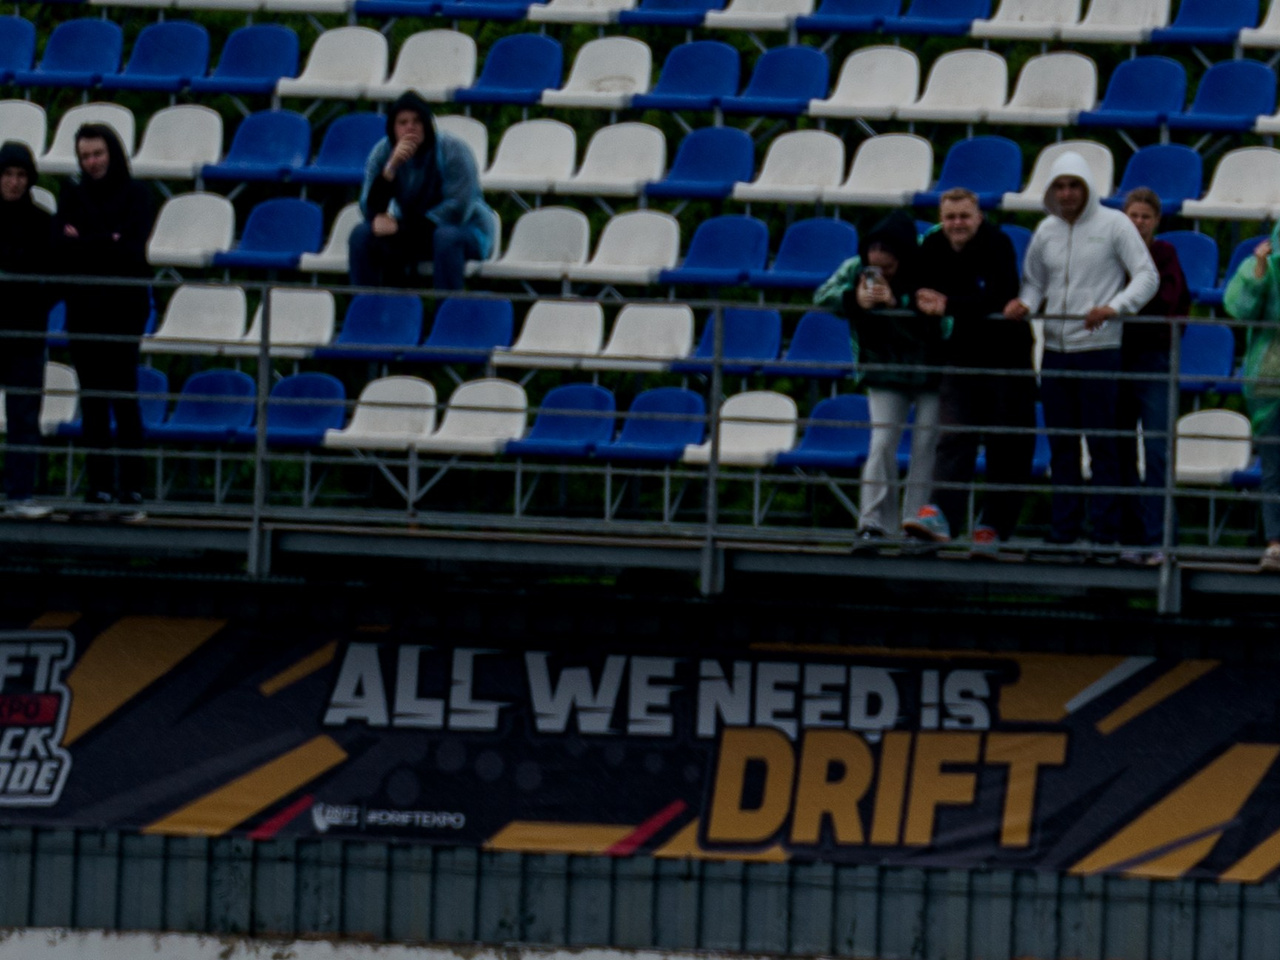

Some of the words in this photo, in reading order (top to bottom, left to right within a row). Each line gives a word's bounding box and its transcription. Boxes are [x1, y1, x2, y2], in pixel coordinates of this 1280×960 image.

[323, 642, 510, 730] ALL
[524, 650, 682, 736] WE
[696, 659, 901, 742] NEED
[920, 669, 992, 729] IS
[706, 727, 1068, 847] DRIFT
